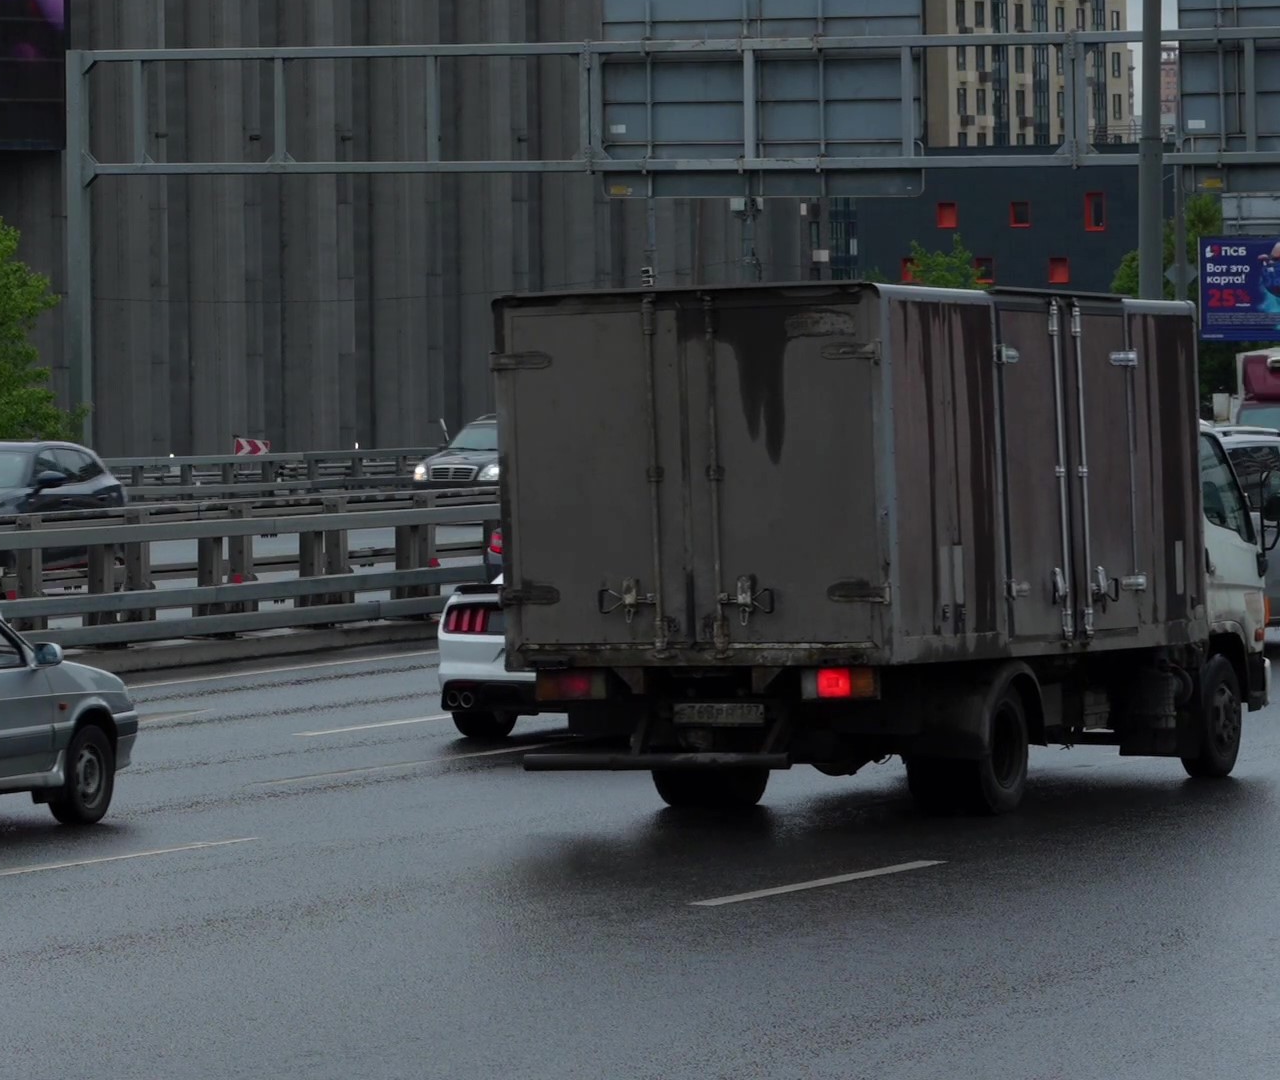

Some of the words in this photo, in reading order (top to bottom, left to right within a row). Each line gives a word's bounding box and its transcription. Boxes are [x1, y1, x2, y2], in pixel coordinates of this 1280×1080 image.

[1221, 246, 1247, 256] ПСБ
[1206, 263, 1227, 273] Вот
[1230, 265, 1250, 273] это
[1206, 274, 1246, 286] карта!
